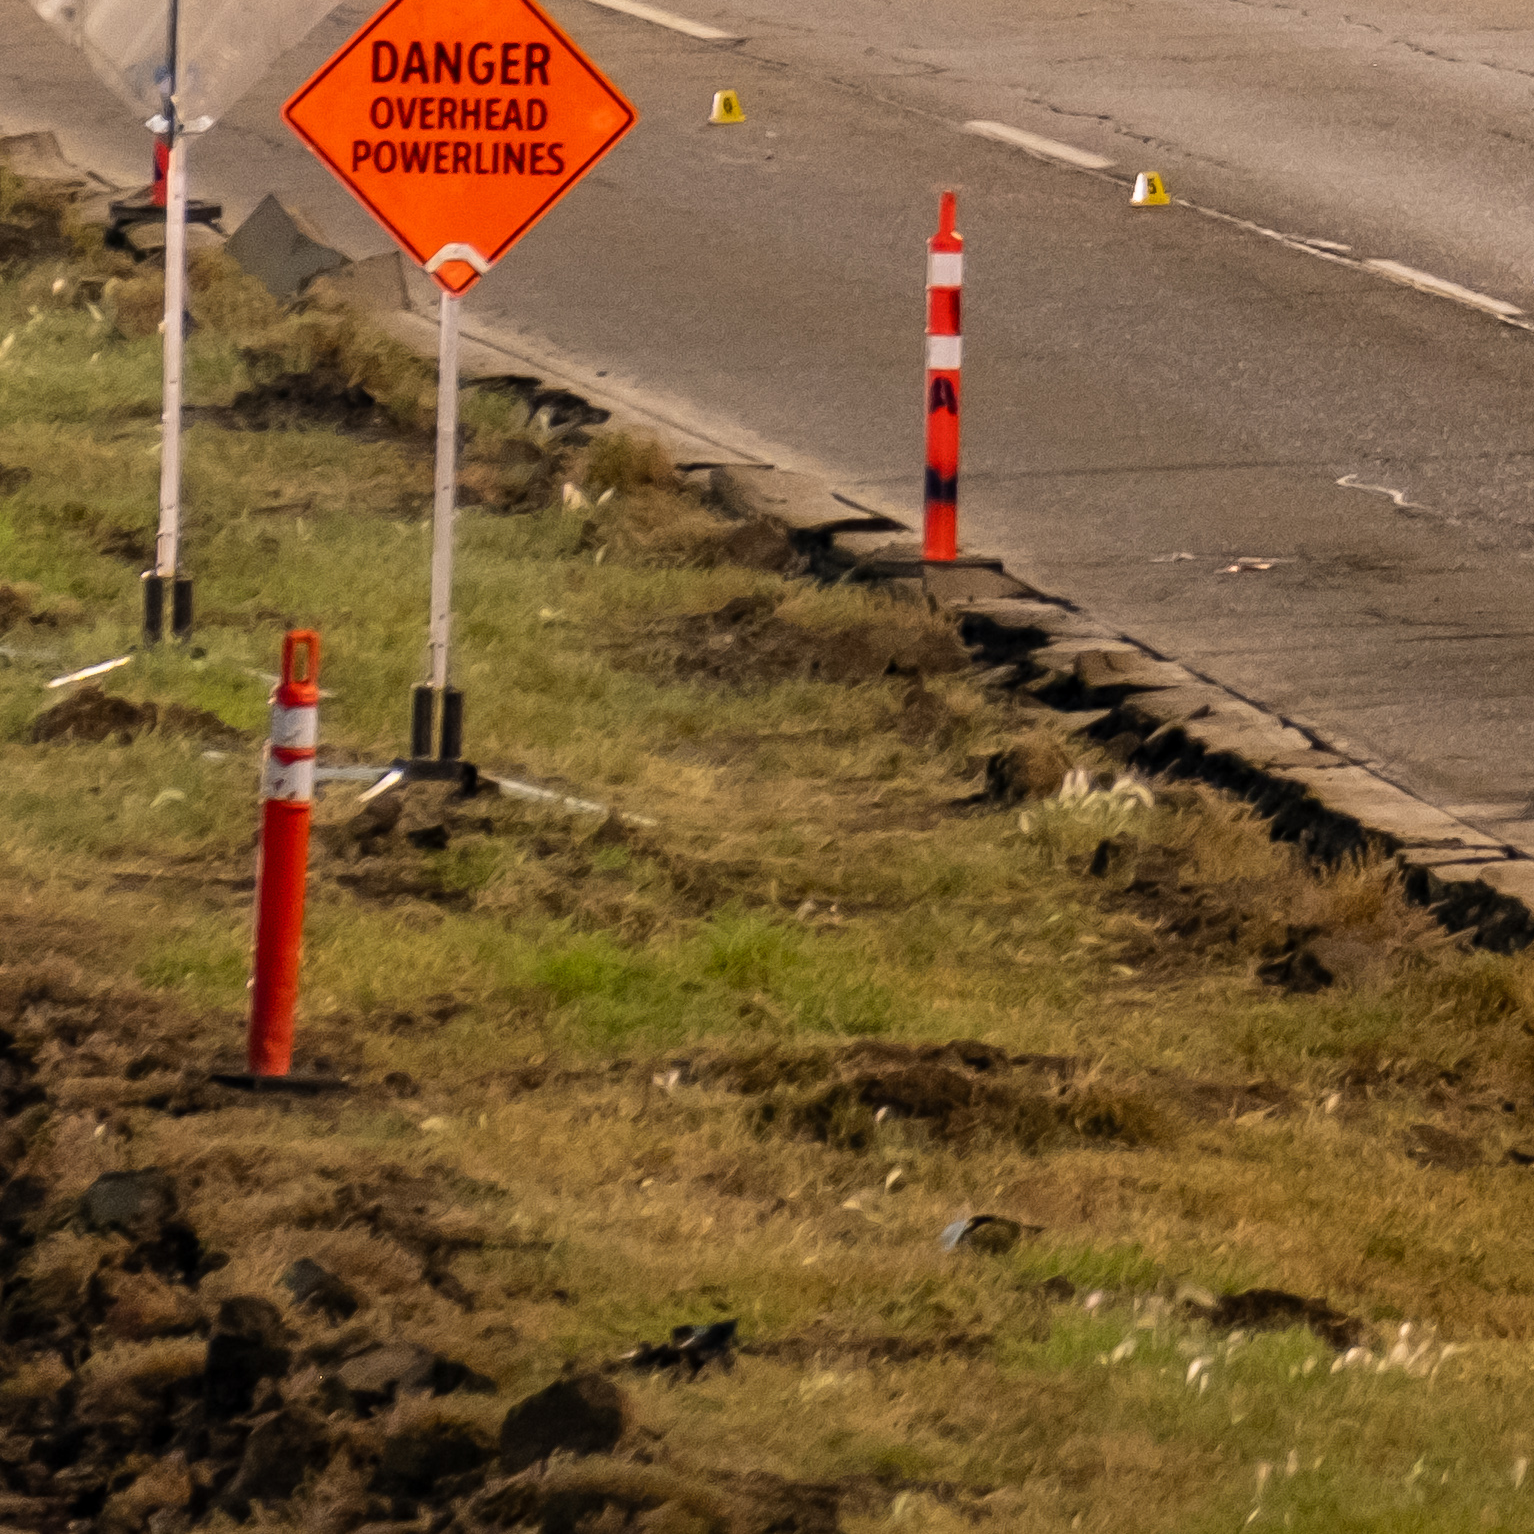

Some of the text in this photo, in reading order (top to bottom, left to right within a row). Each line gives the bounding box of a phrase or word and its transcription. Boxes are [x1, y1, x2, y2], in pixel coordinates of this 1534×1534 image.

[370, 40, 552, 86] DANGER
[369, 96, 549, 132] OVERHEAD
[351, 139, 566, 177] POWERLINES
